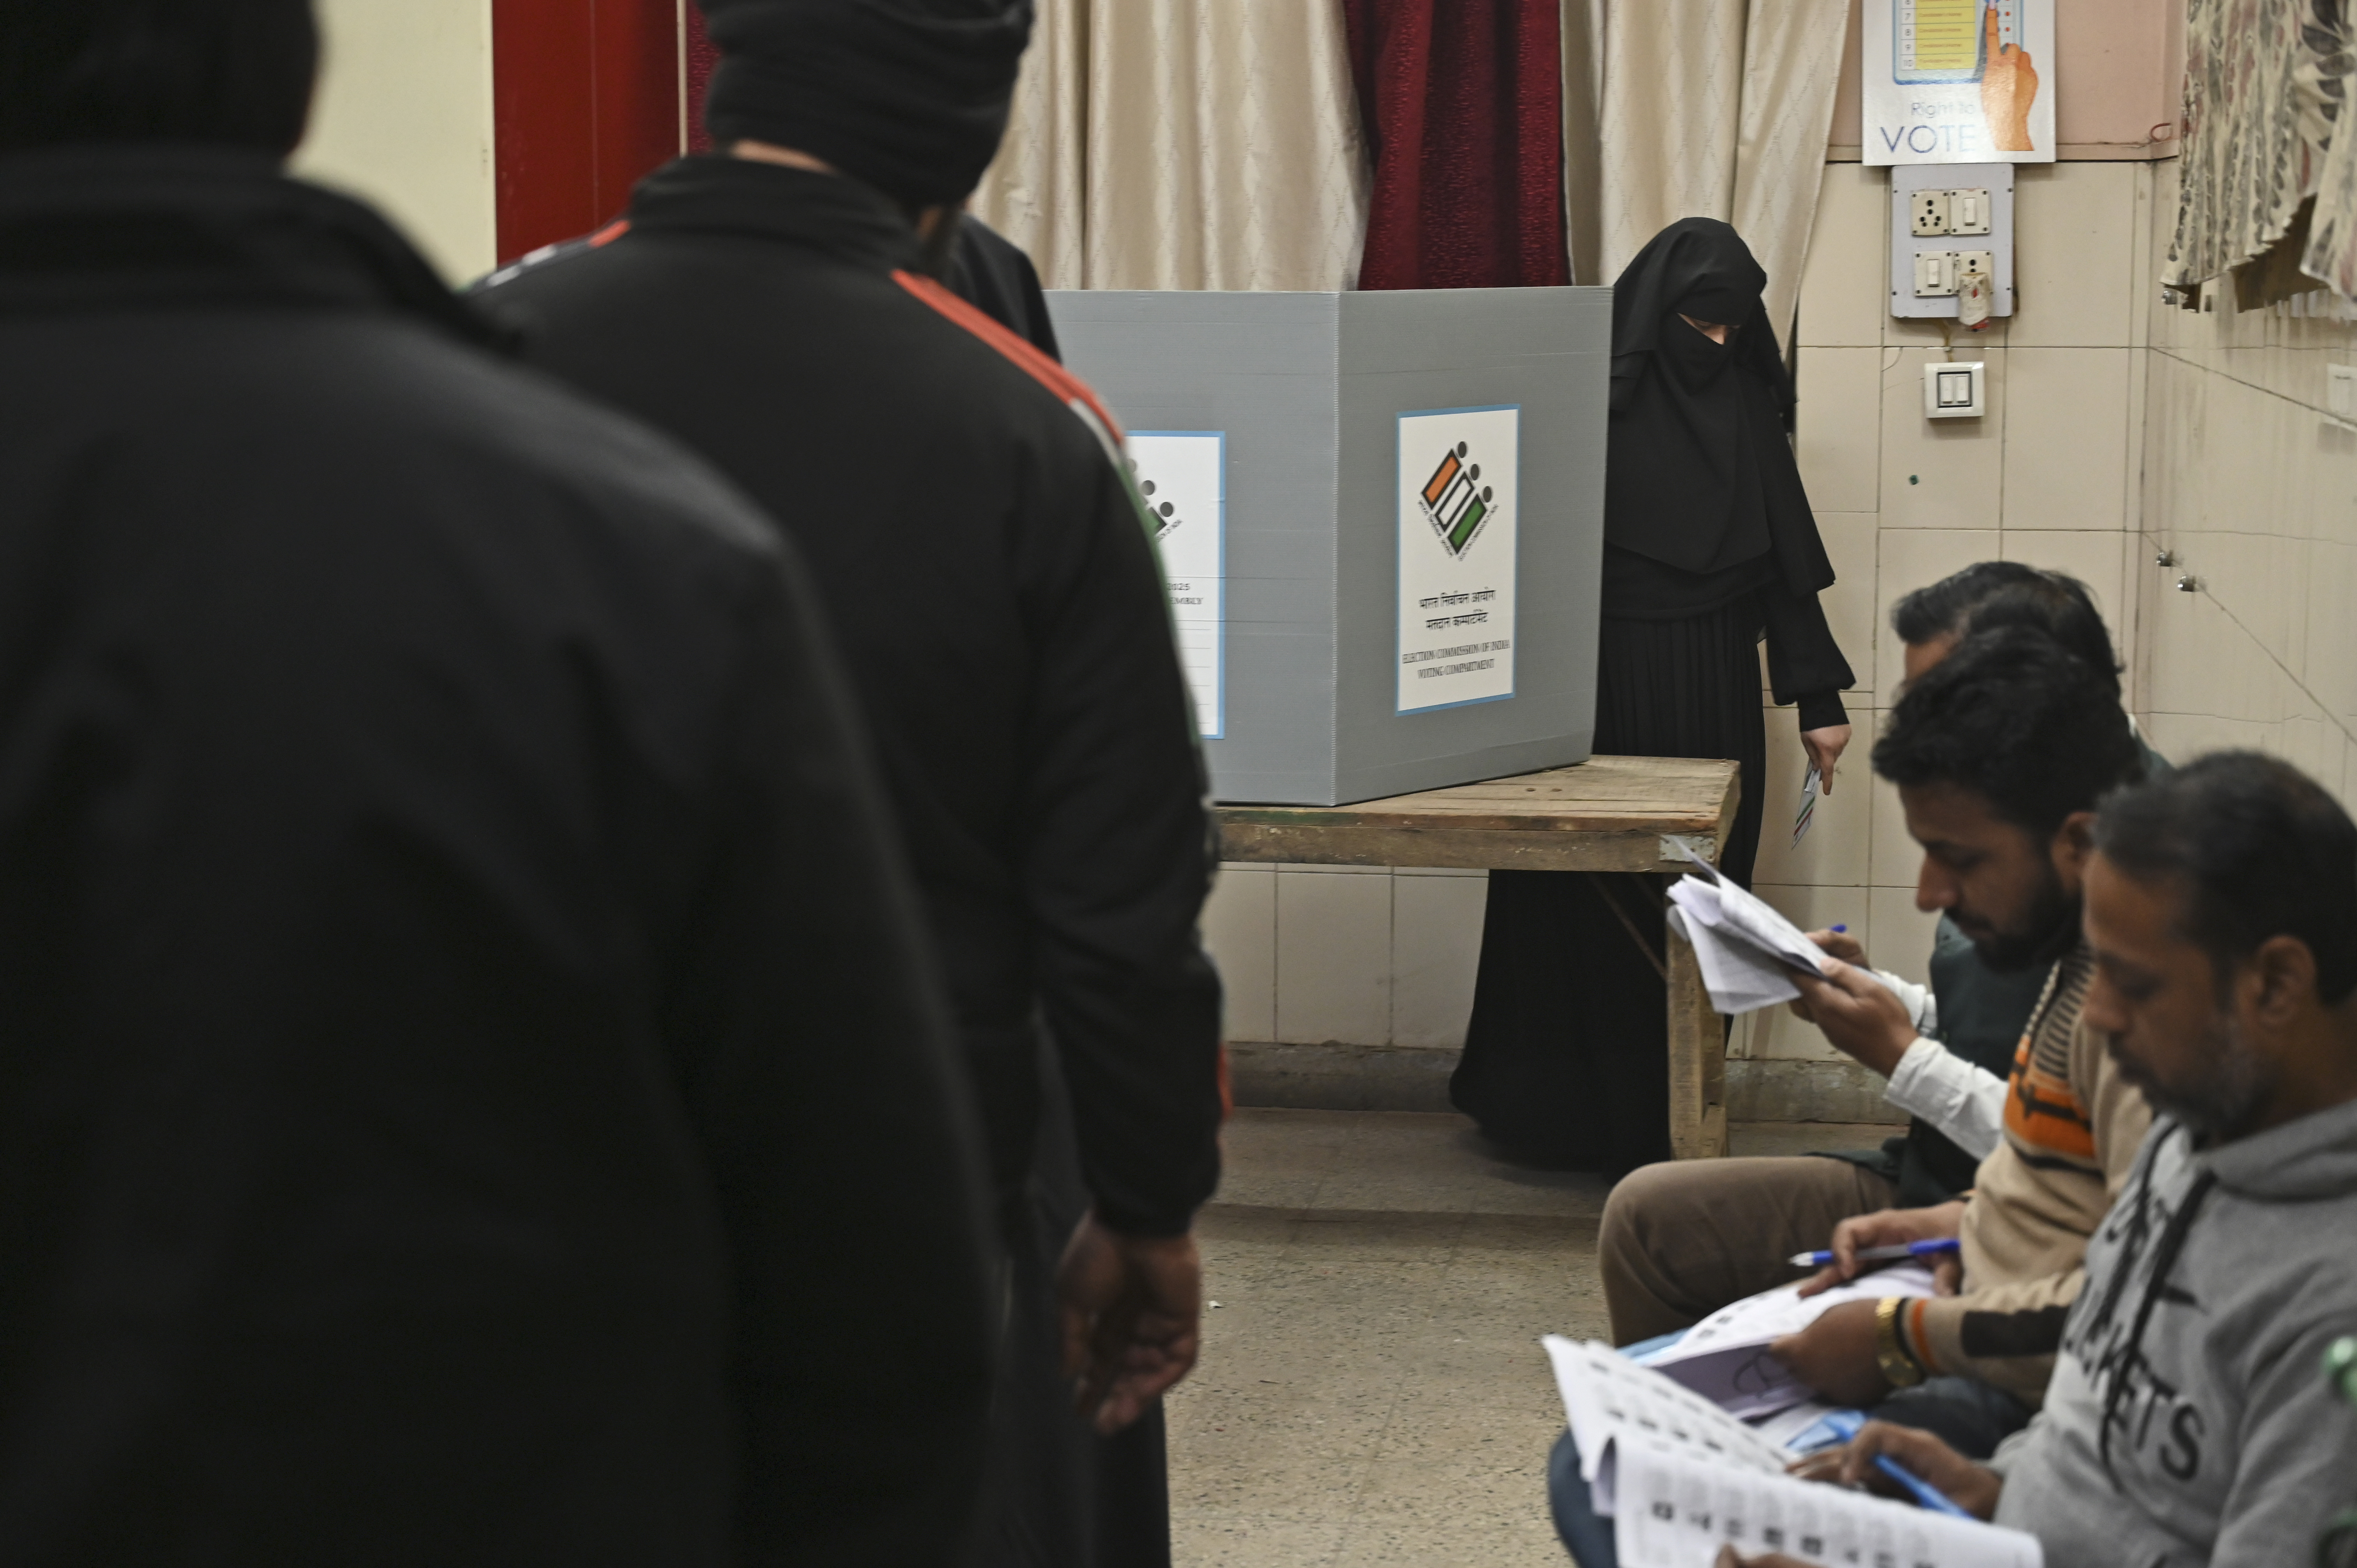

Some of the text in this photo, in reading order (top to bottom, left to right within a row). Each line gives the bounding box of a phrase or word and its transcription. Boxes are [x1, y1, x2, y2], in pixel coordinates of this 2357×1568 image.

[1911, 102, 1975, 118] Right to
[1880, 125, 1975, 153] VOTE
[1419, 586, 1496, 609] भारत निर्वाचन आयोग
[1426, 617, 1451, 630] मतदान
[1403, 639, 1510, 664] ELECTION COMMISSION OF INDIA
[1418, 659, 1495, 679] VOTING COMPARTMENT
